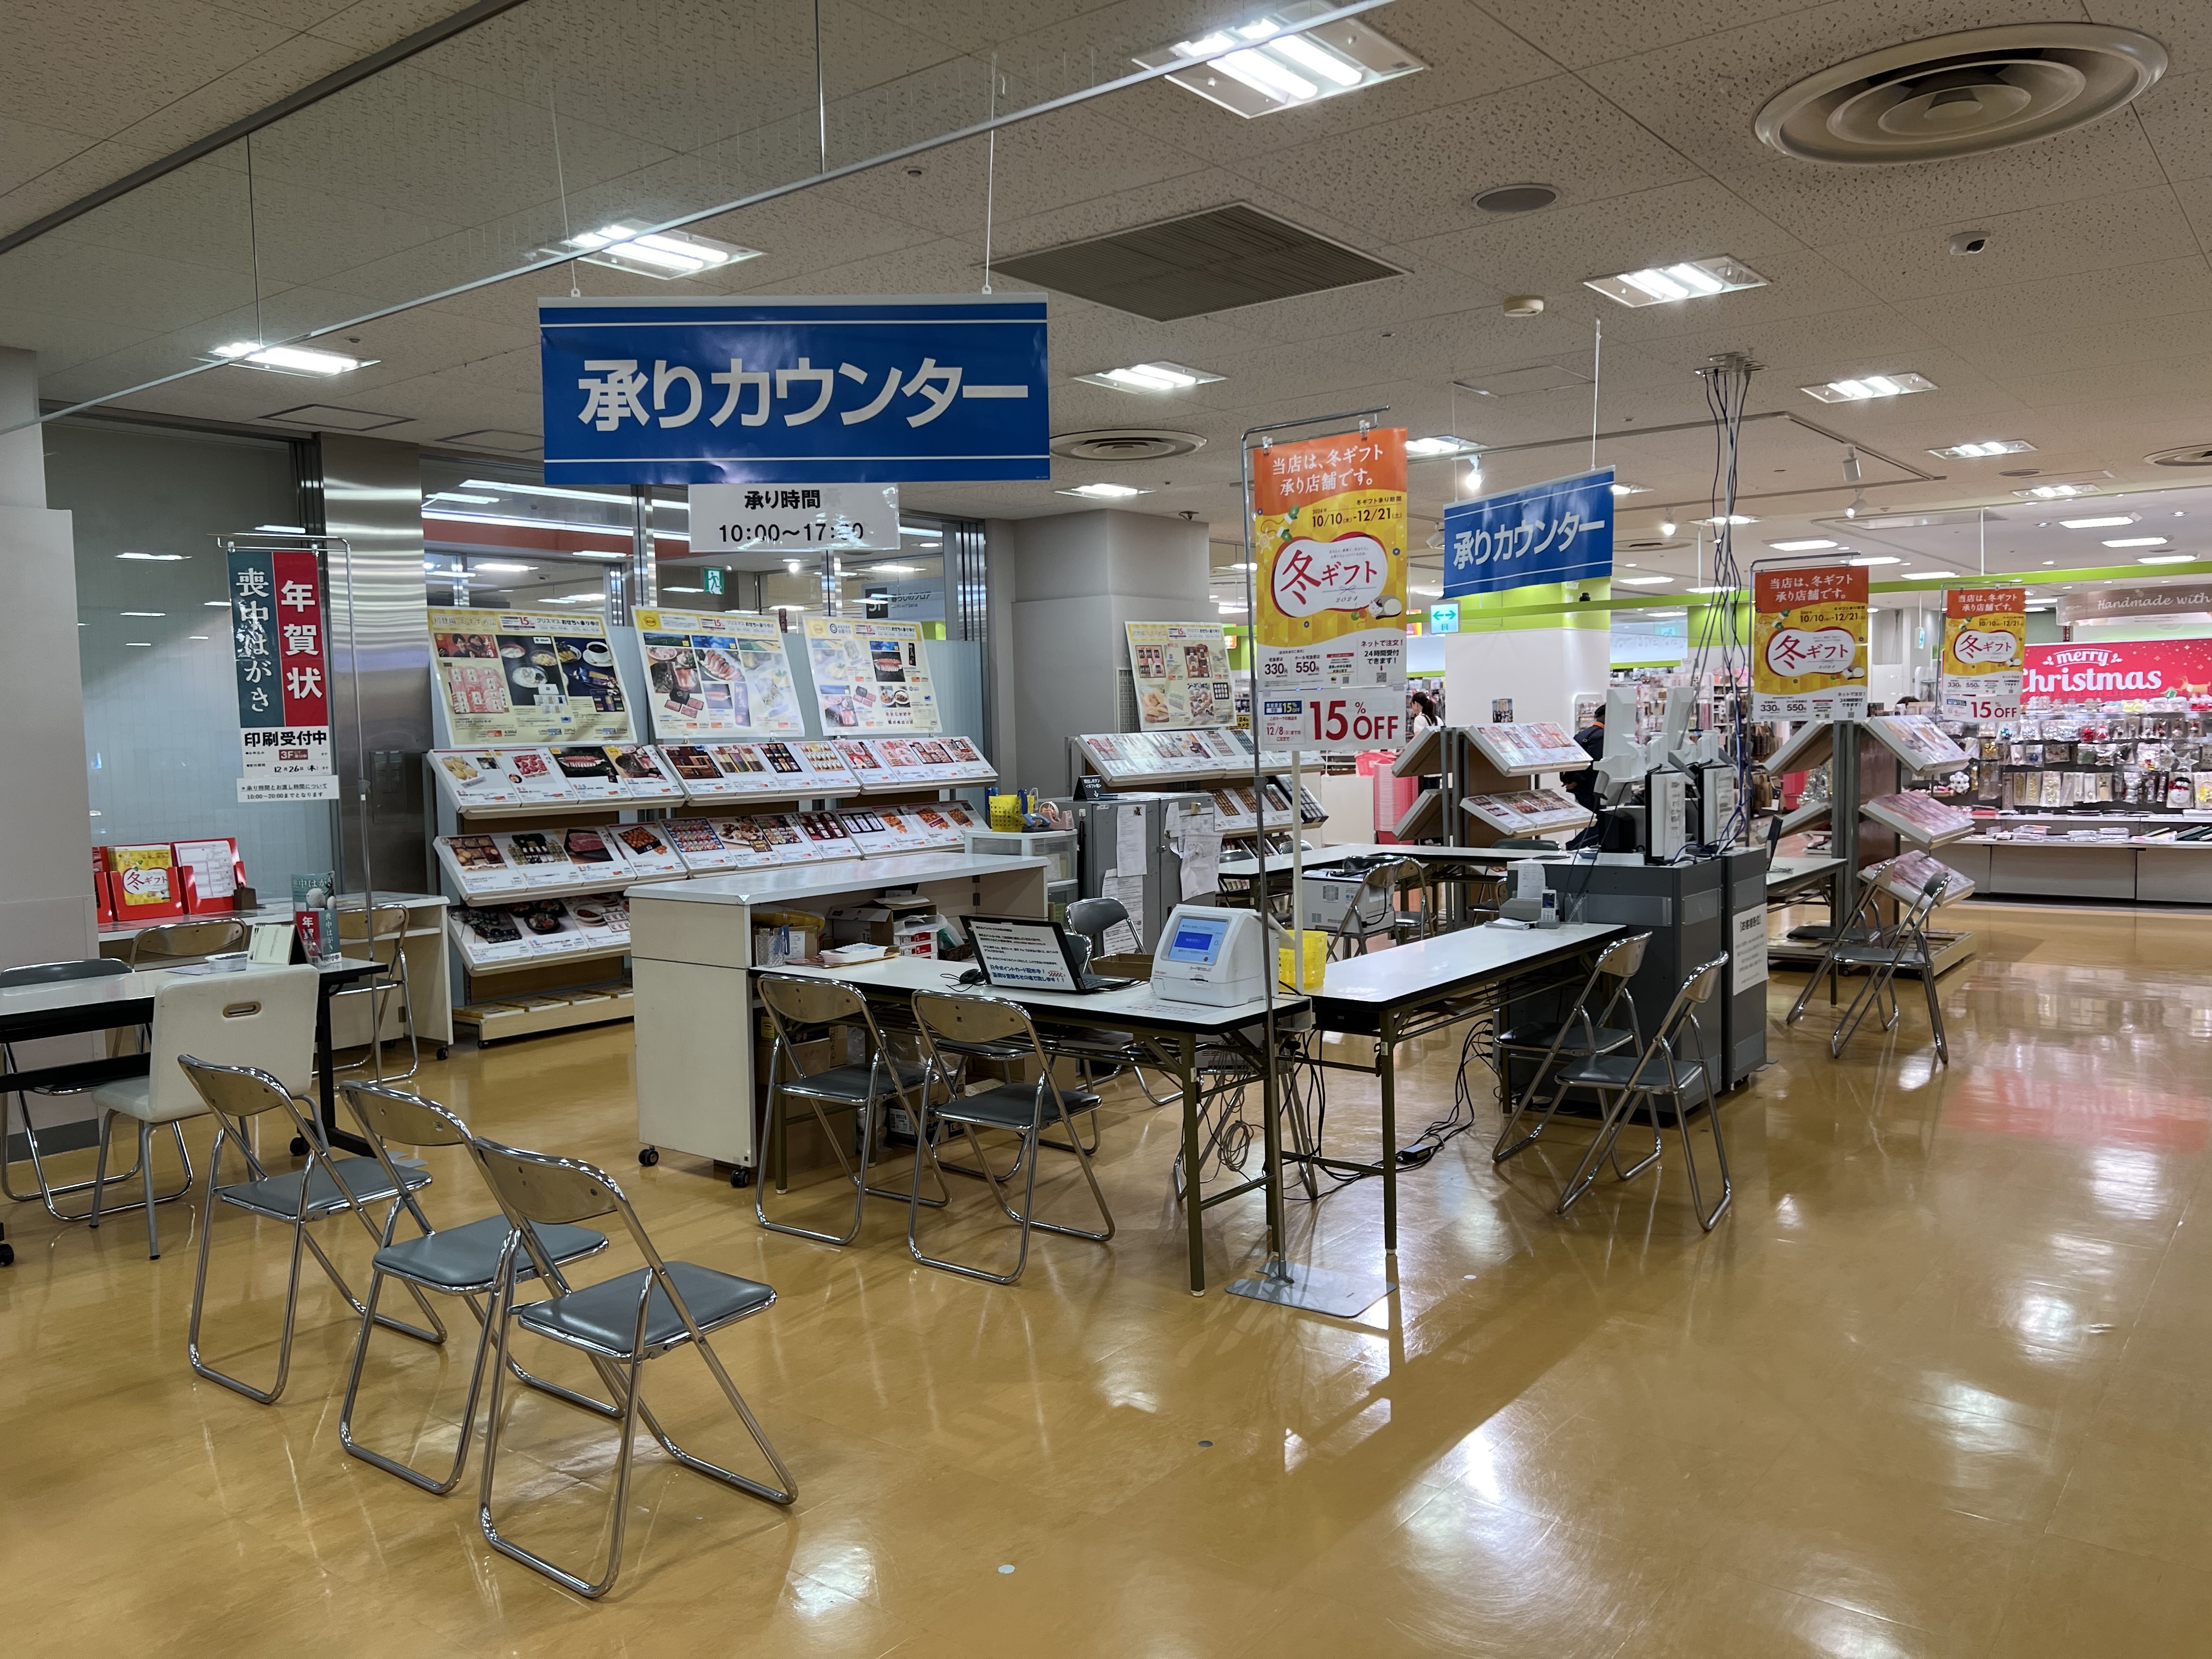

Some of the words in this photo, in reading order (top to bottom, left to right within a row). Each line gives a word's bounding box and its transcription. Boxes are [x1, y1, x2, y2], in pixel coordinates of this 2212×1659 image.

[578, 357, 1029, 432] 承りカウンター
[1272, 444, 1383, 475] 当店は、冬ギフト
[1280, 467, 1373, 496] 承り店舗です。
[744, 489, 821, 510] 承り時間
[1453, 511, 1605, 570] 承りカウンター
[1280, 549, 1378, 605] 冬ギフト
[1769, 574, 1853, 590] 当店は、冬ギフト
[1775, 588, 1846, 602] 承り店舗です。
[2097, 595, 2174, 610] Handmade
[2177, 592, 2212, 605] with
[236, 567, 273, 712] 喪中はがき
[280, 580, 323, 699] 年賀状
[1773, 635, 1848, 670] 冬ギフト
[1959, 635, 2012, 658] 冬ギフト
[2056, 650, 2109, 667] merry
[1310, 701, 1348, 741] 15
[1353, 715, 1398, 740] OFF
[1971, 701, 1991, 718] 15
[1994, 707, 2017, 718] OFF
[245, 730, 327, 747] 印刷受付中
[127, 871, 168, 890] 冬ギフト
